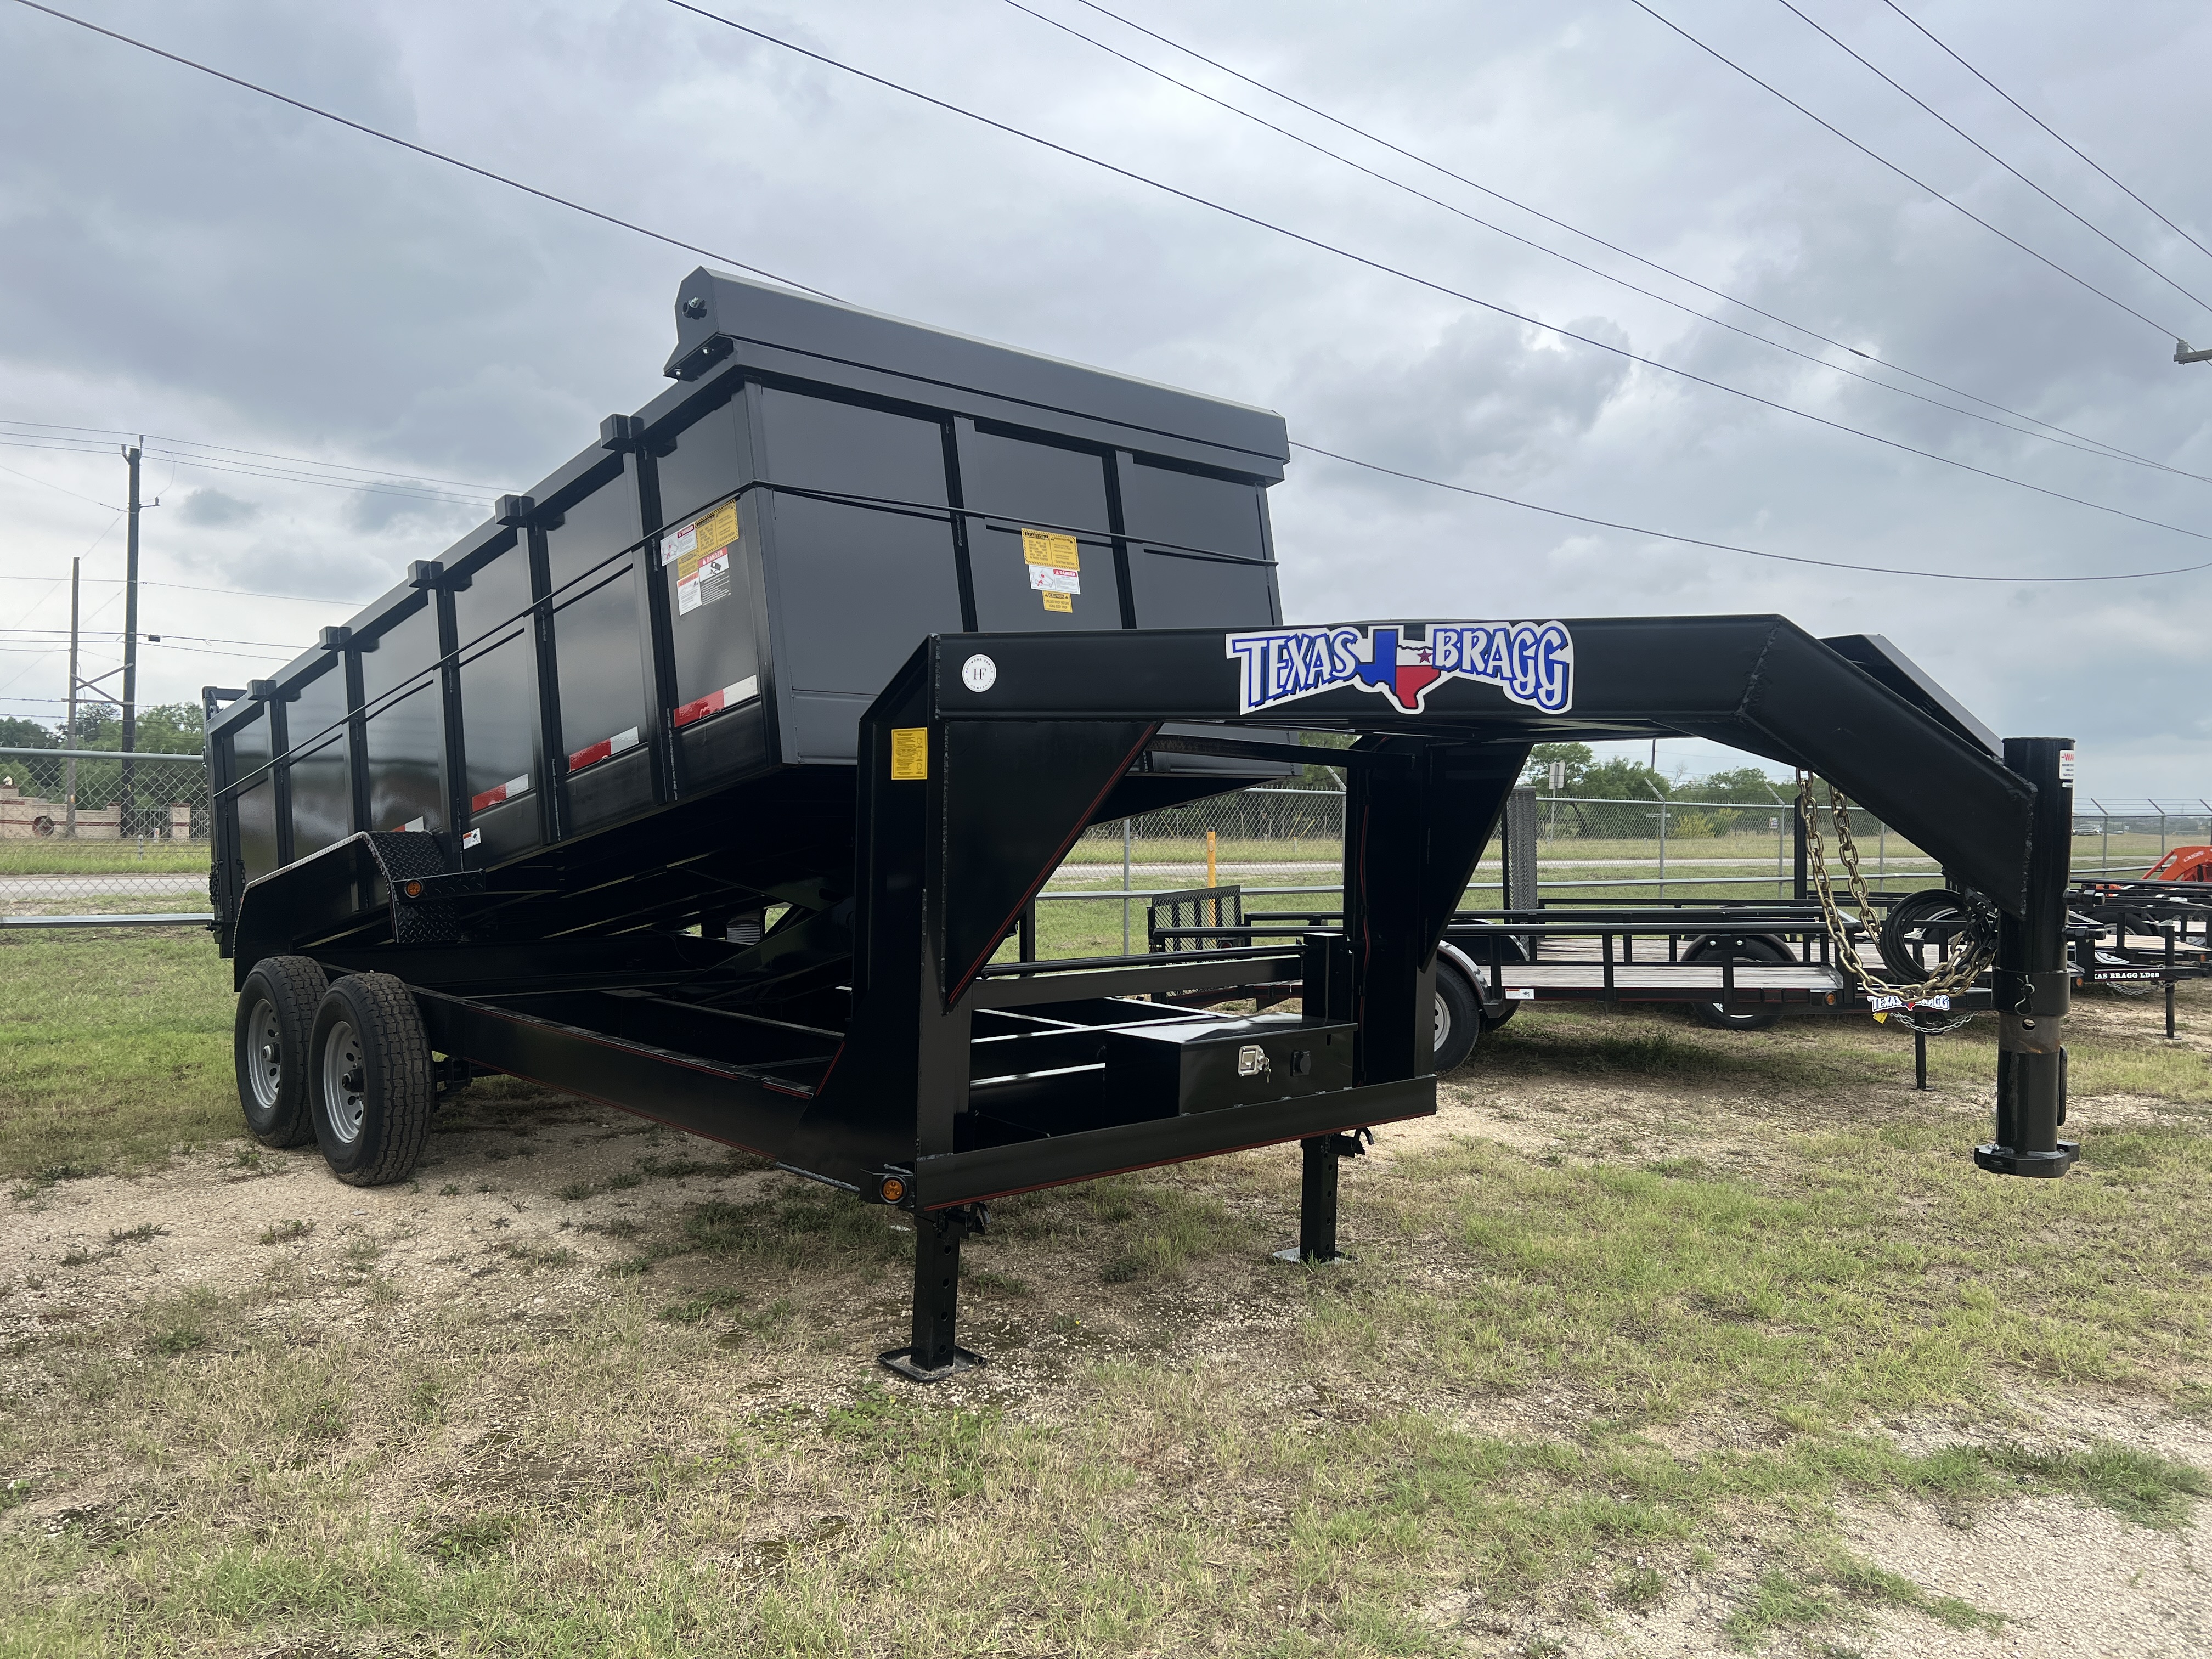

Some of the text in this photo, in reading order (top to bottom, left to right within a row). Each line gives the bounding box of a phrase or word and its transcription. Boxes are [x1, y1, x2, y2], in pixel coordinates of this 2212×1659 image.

[707, 550, 723, 563] DANGER
[973, 668, 986, 680] HF
[1232, 626, 1568, 710] TEXAS BRAGG
[1868, 995, 1949, 1011] TEXAS RAGG
